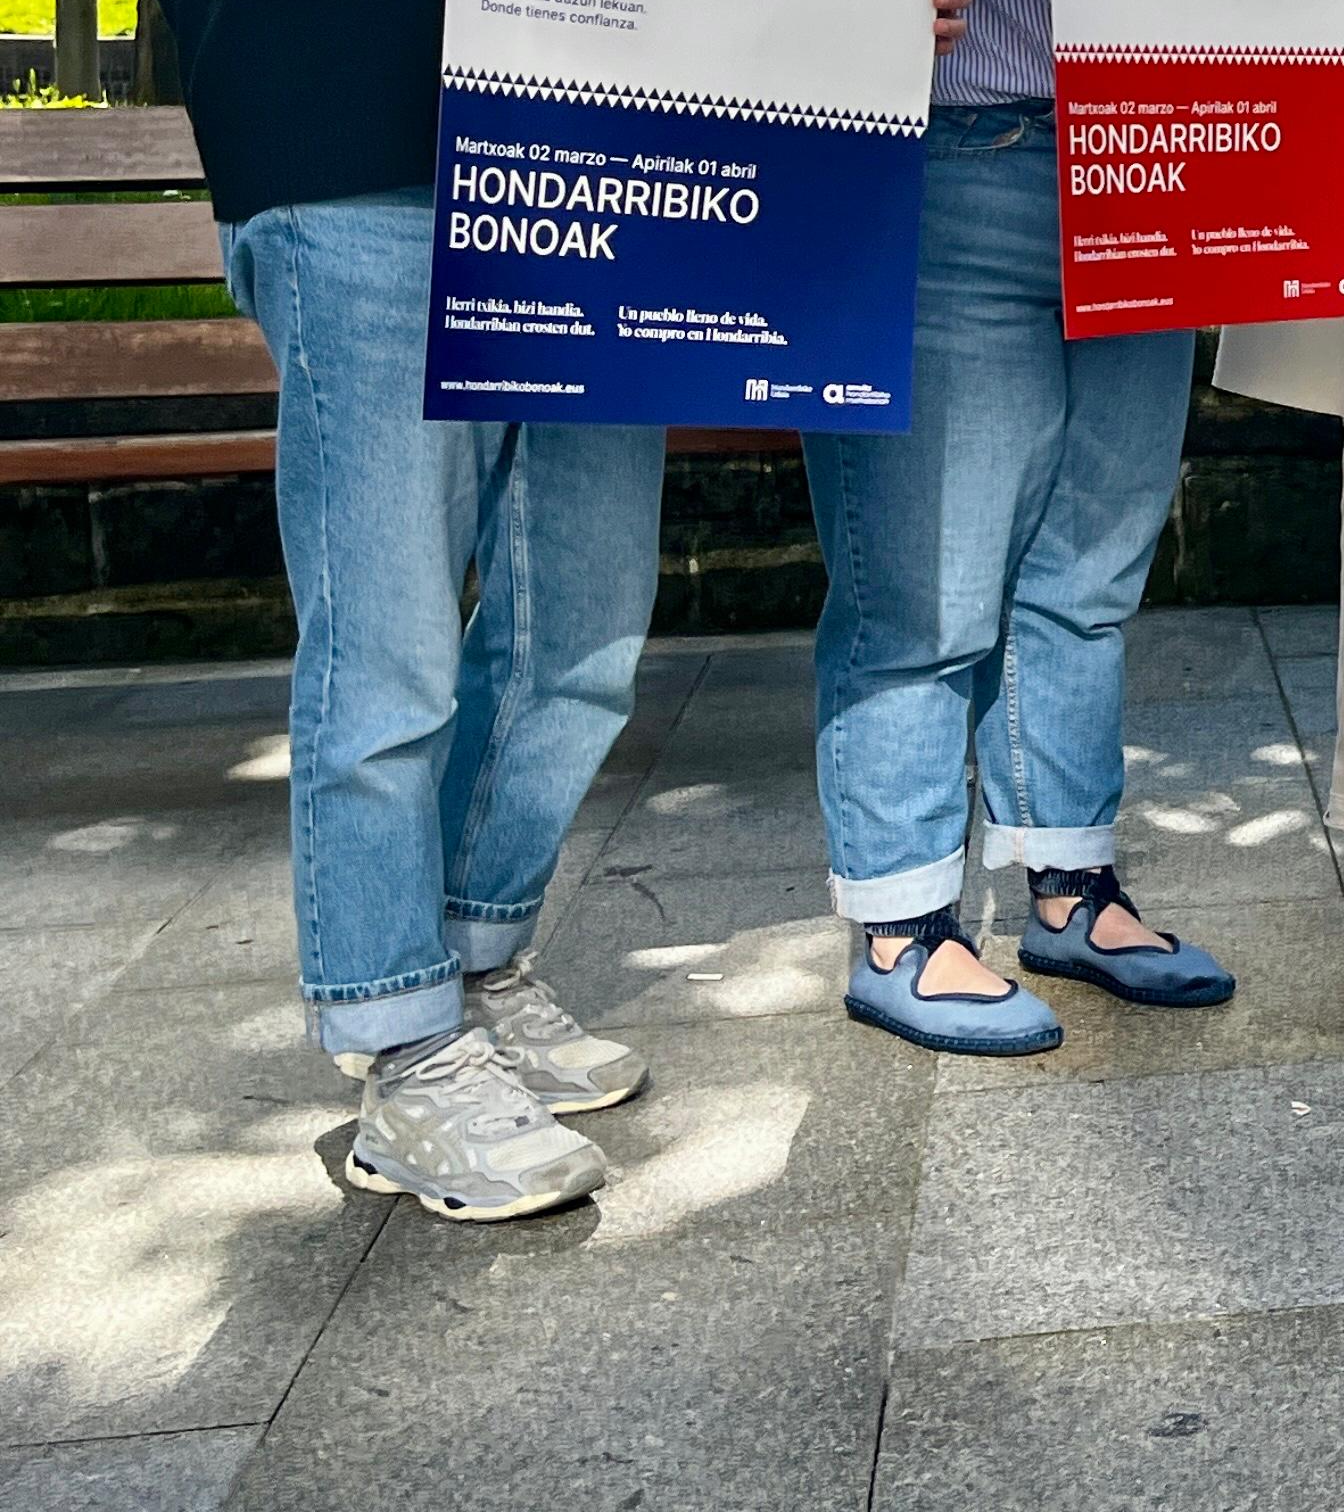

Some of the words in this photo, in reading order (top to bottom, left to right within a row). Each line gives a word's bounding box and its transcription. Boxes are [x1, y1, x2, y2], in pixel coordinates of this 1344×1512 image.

[481, 0, 521, 16] Donde
[526, 6, 565, 21] tienes
[570, 13, 637, 30] confianza.
[1120, 101, 1135, 114] 02
[1138, 104, 1174, 114] marzo
[1191, 101, 1233, 116] Apirilak
[1237, 101, 1249, 114] 01
[1252, 101, 1276, 113] abril
[1070, 123, 1280, 155] HONDARRIBIKO
[456, 136, 525, 158] Martxoak
[529, 144, 550, 161] 02
[555, 150, 606, 165] marzo
[632, 154, 694, 173] Apirilak
[698, 160, 717, 175] 01
[721, 163, 756, 178] abril
[453, 164, 759, 223] HONDARRIBIKO
[1071, 162, 1185, 195] BONOAK
[449, 212, 618, 260] BONOAK
